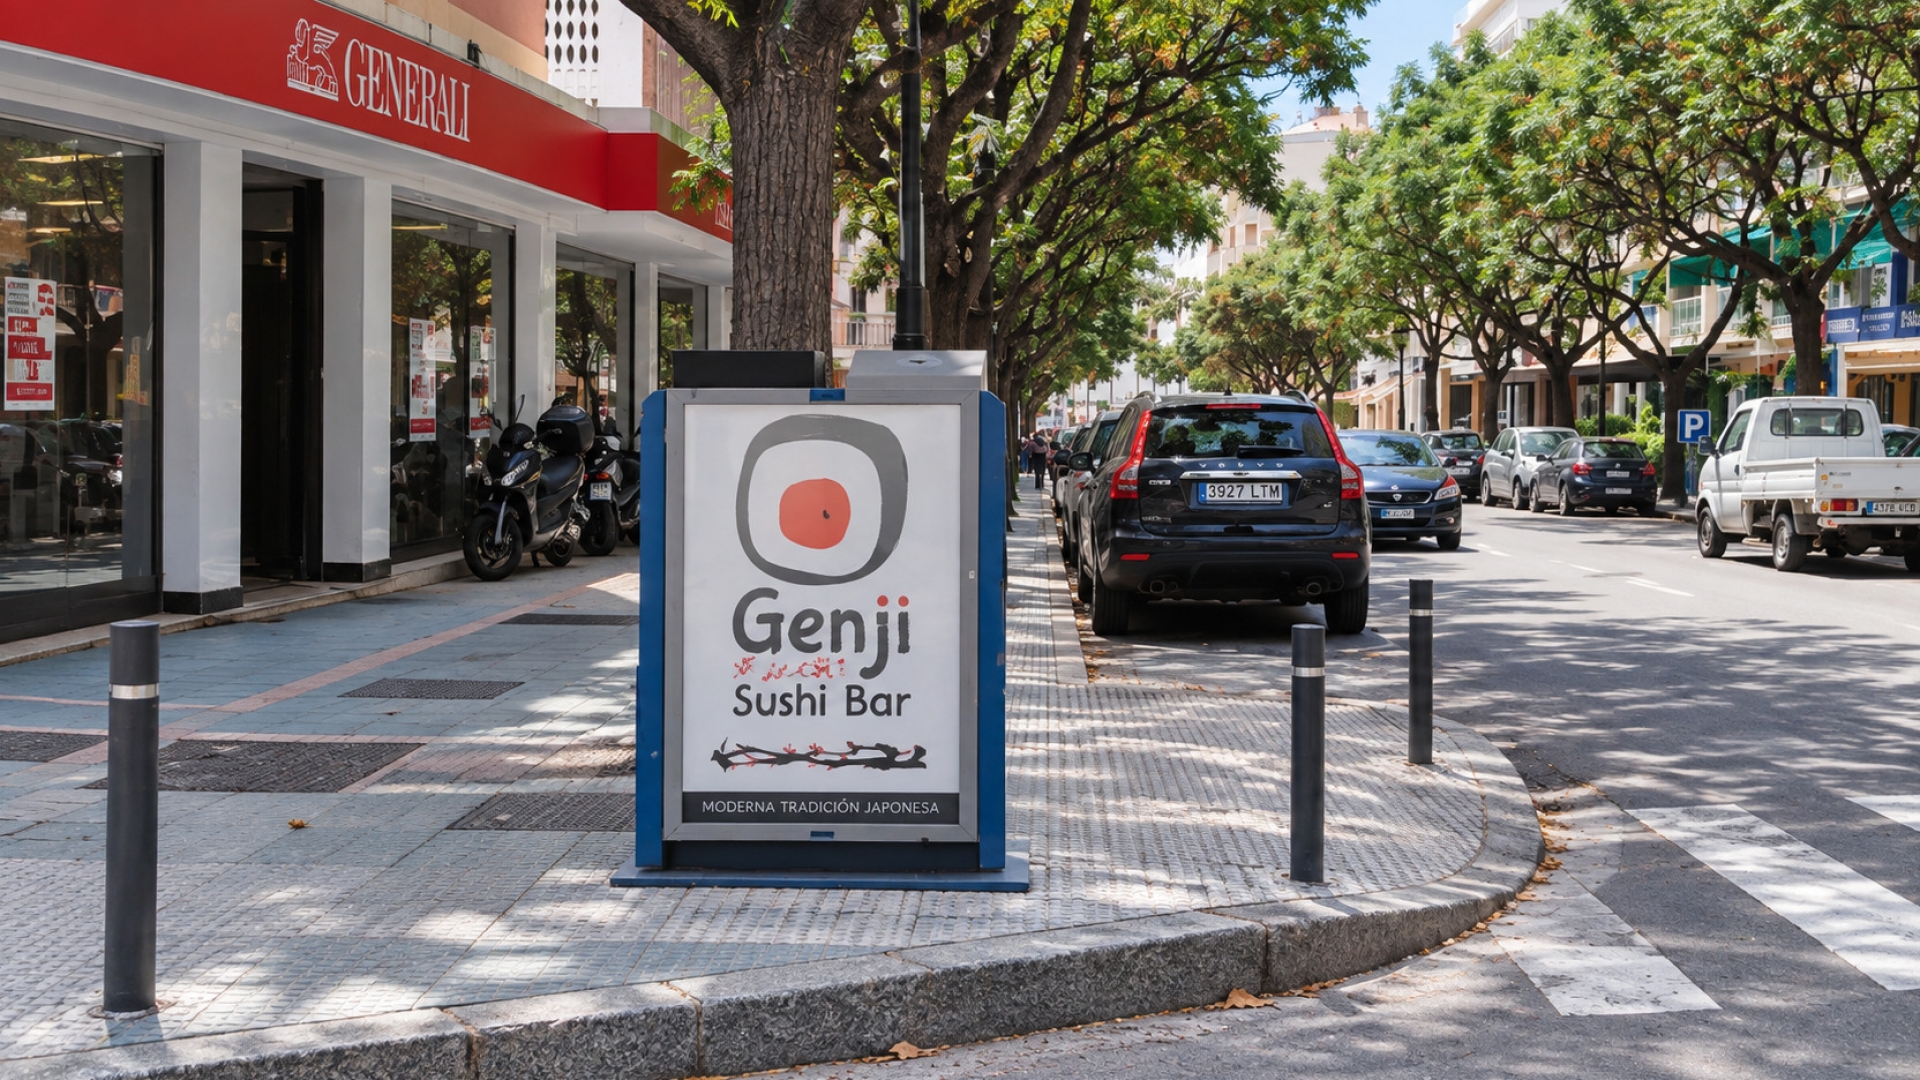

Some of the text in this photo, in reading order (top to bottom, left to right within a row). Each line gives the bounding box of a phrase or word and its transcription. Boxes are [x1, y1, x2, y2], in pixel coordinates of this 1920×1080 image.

[344, 38, 471, 142] GENERALI
[1685, 413, 1704, 438] P
[1208, 485, 1280, 499] 3927 LTM
[732, 587, 911, 680] Genji
[733, 683, 912, 717] Sushi Bar
[702, 798, 940, 814] MODERNA TRADICIÓN JAPONESA
